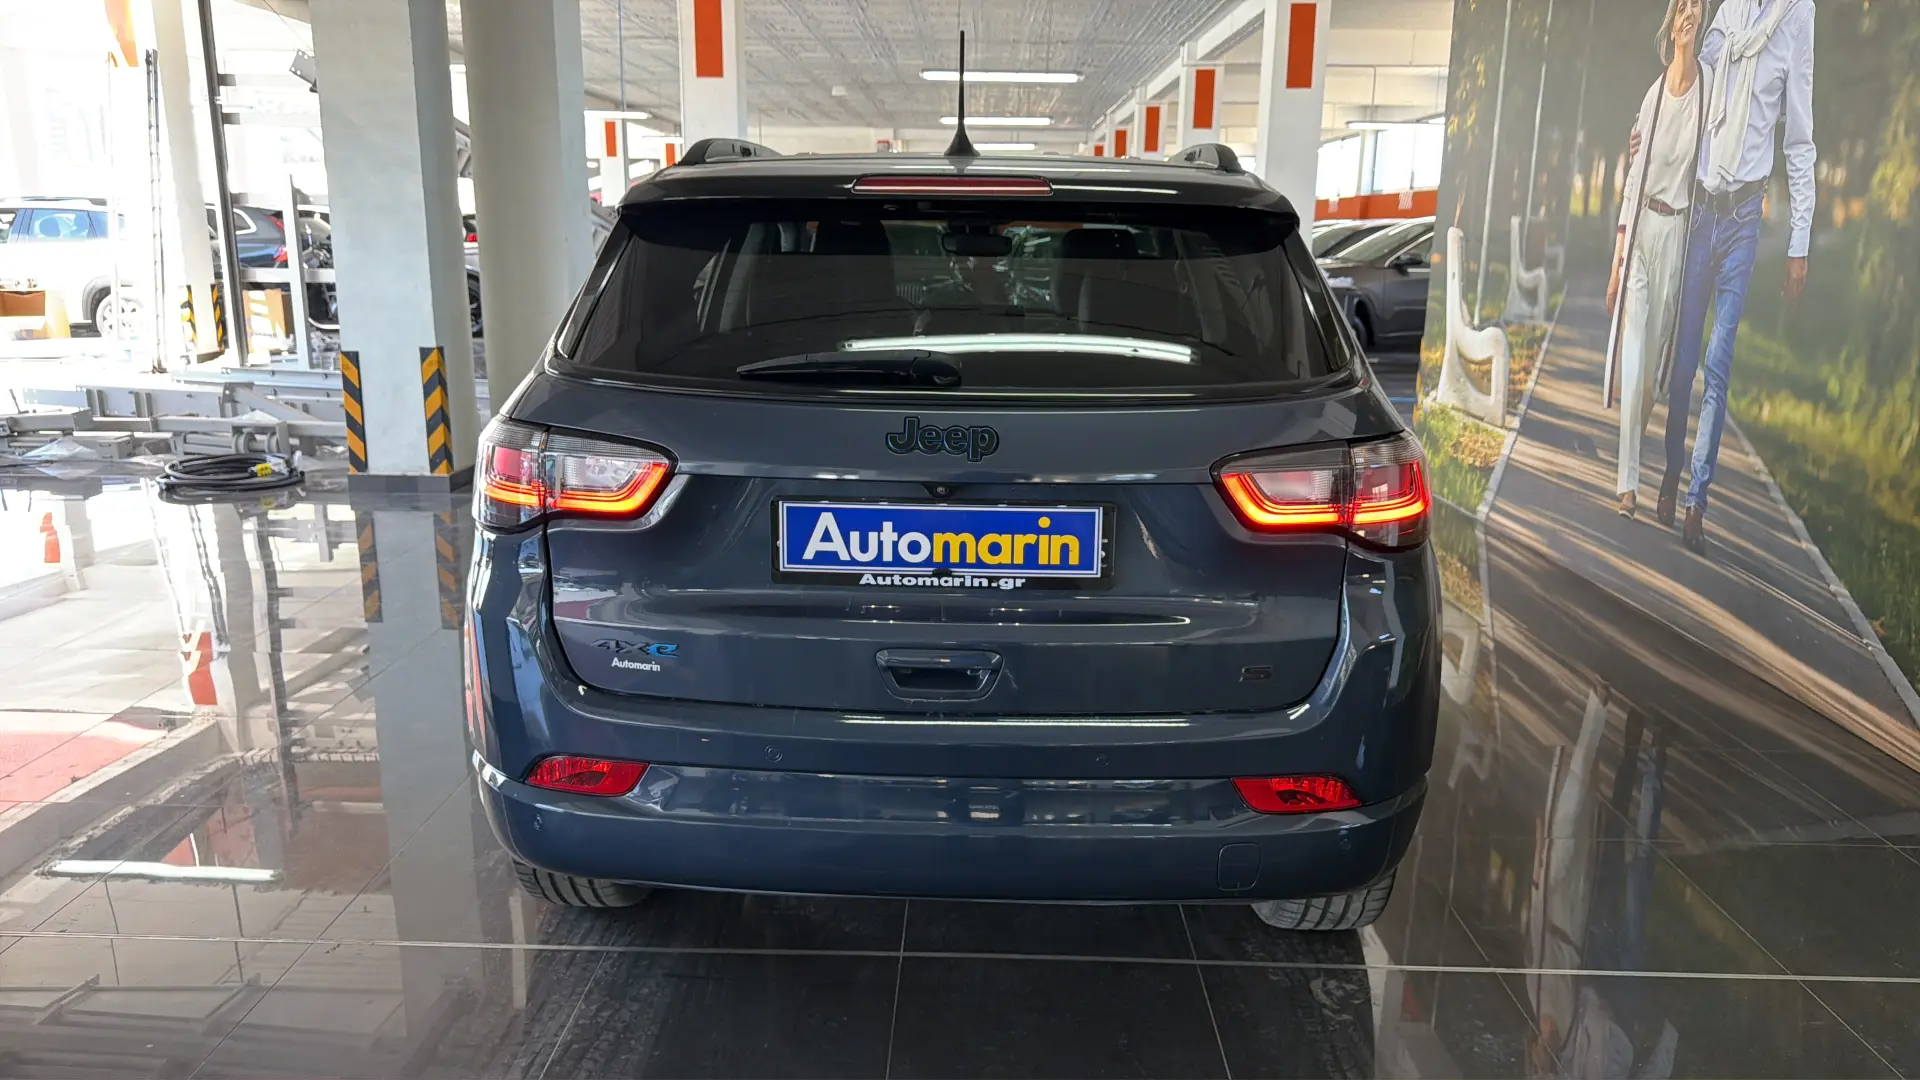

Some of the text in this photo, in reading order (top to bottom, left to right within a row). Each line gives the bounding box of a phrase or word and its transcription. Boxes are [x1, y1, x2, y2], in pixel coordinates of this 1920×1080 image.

[886, 416, 1000, 462] Jeep
[802, 511, 1080, 566] Automarin
[858, 573, 1026, 590] Automarin.gr
[611, 656, 661, 672] Automarin
